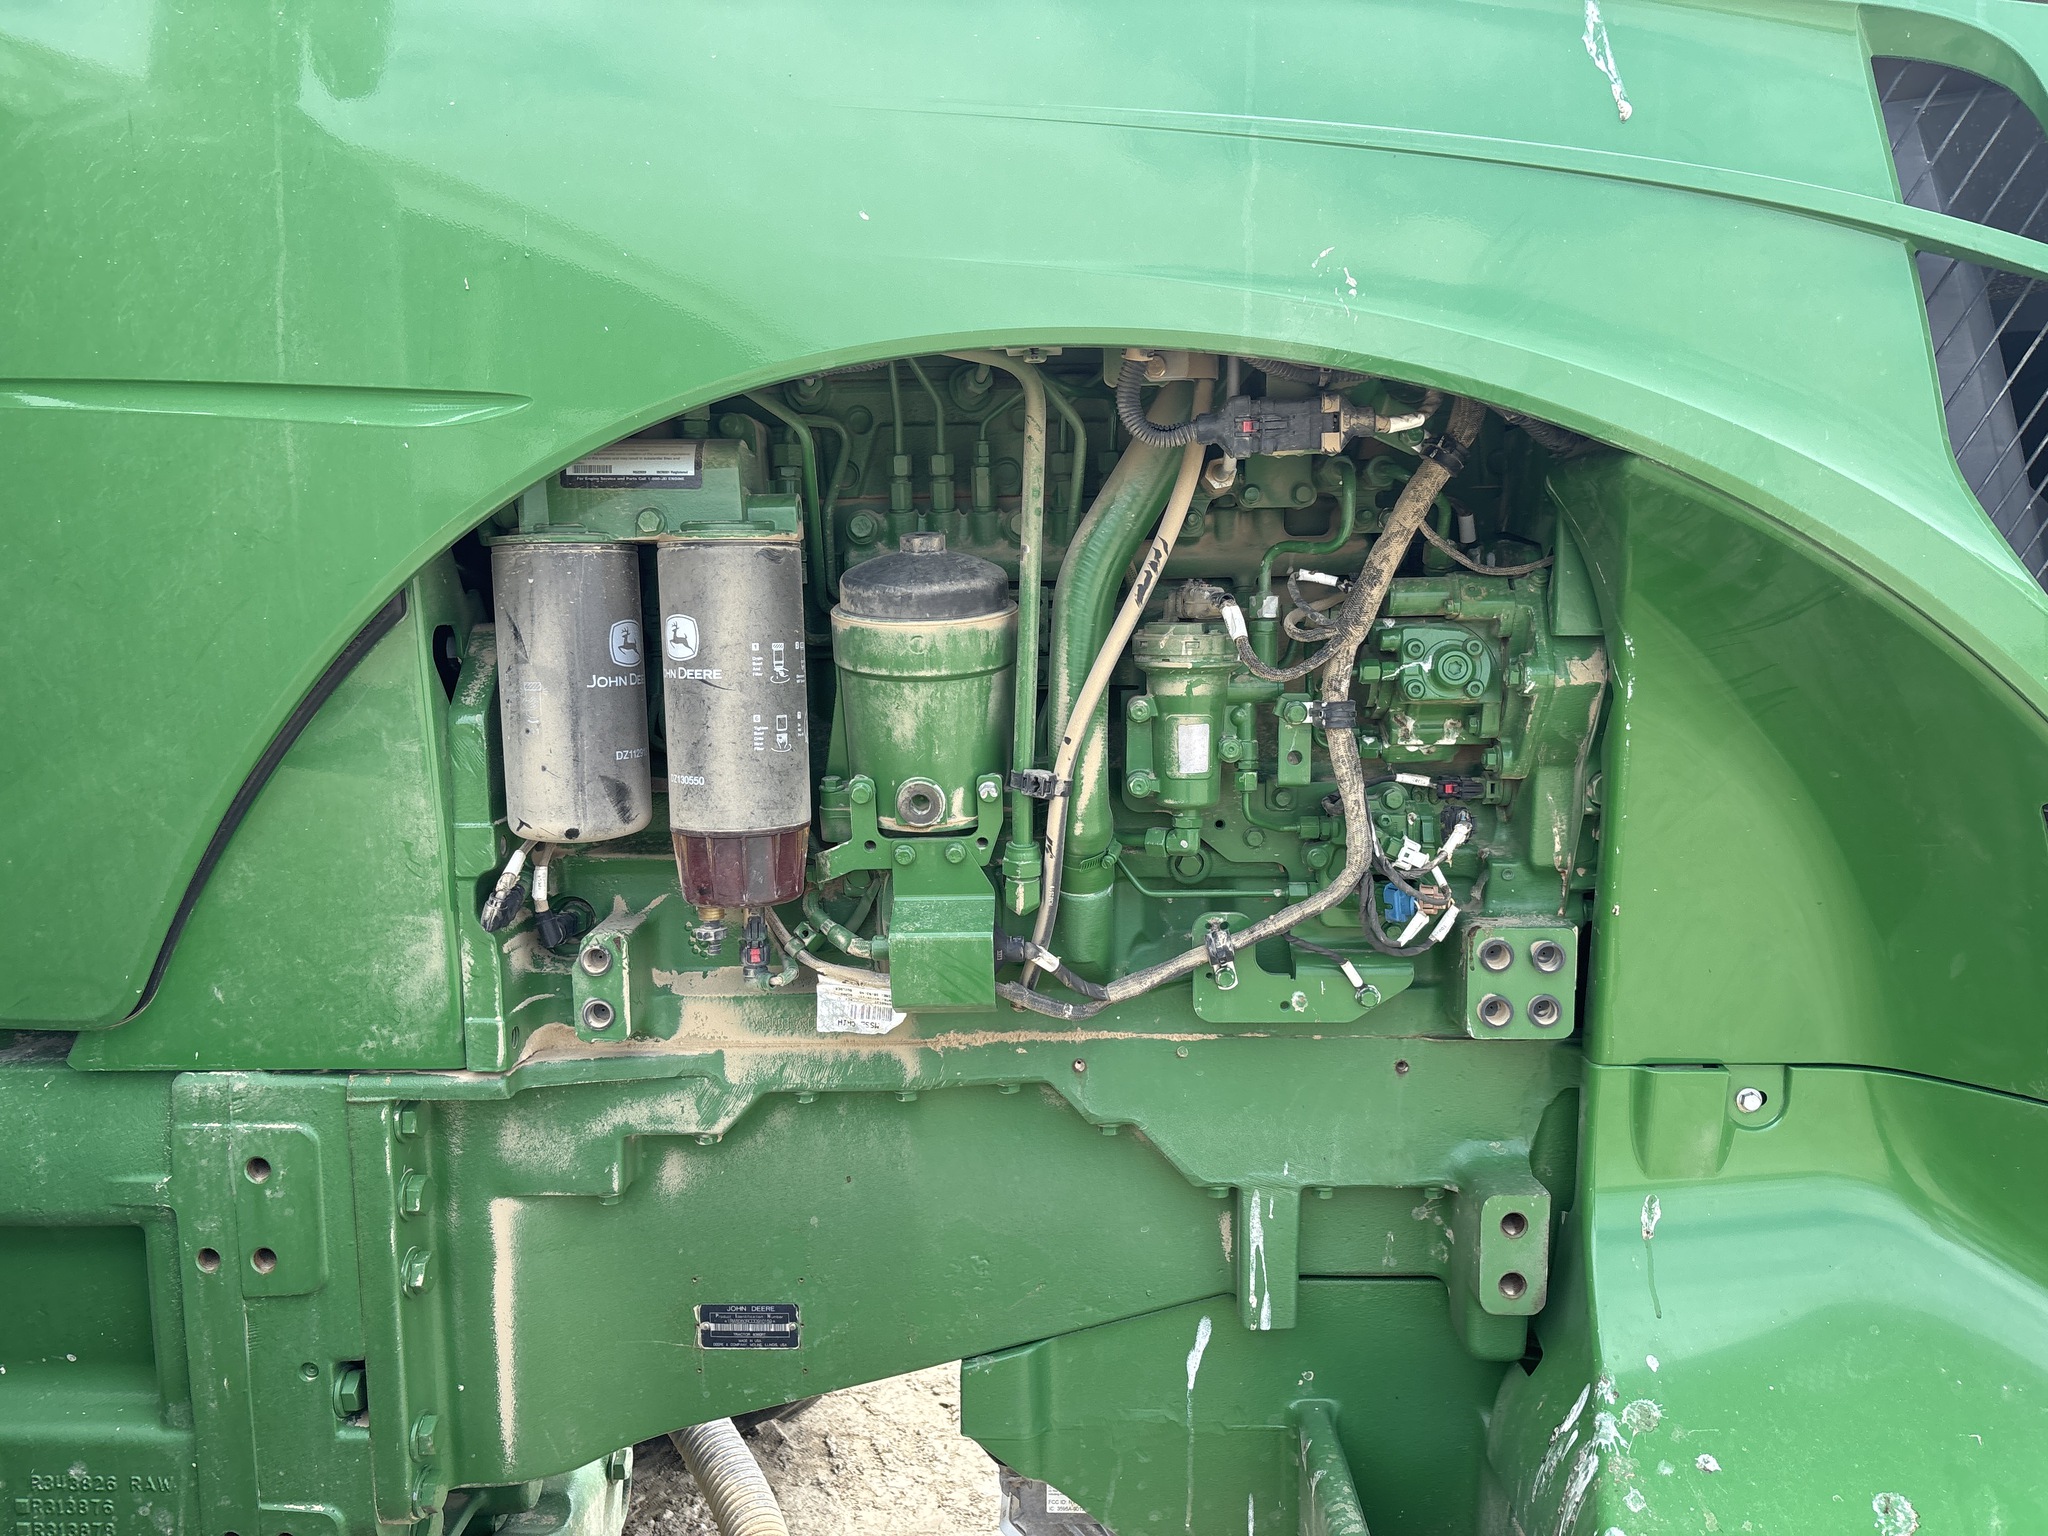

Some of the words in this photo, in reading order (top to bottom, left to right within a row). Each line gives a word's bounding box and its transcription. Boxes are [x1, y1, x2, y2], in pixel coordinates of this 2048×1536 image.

[678, 667, 723, 680] DEERE
[586, 674, 628, 688] JOHN
[130, 1475, 174, 1492] RAW
